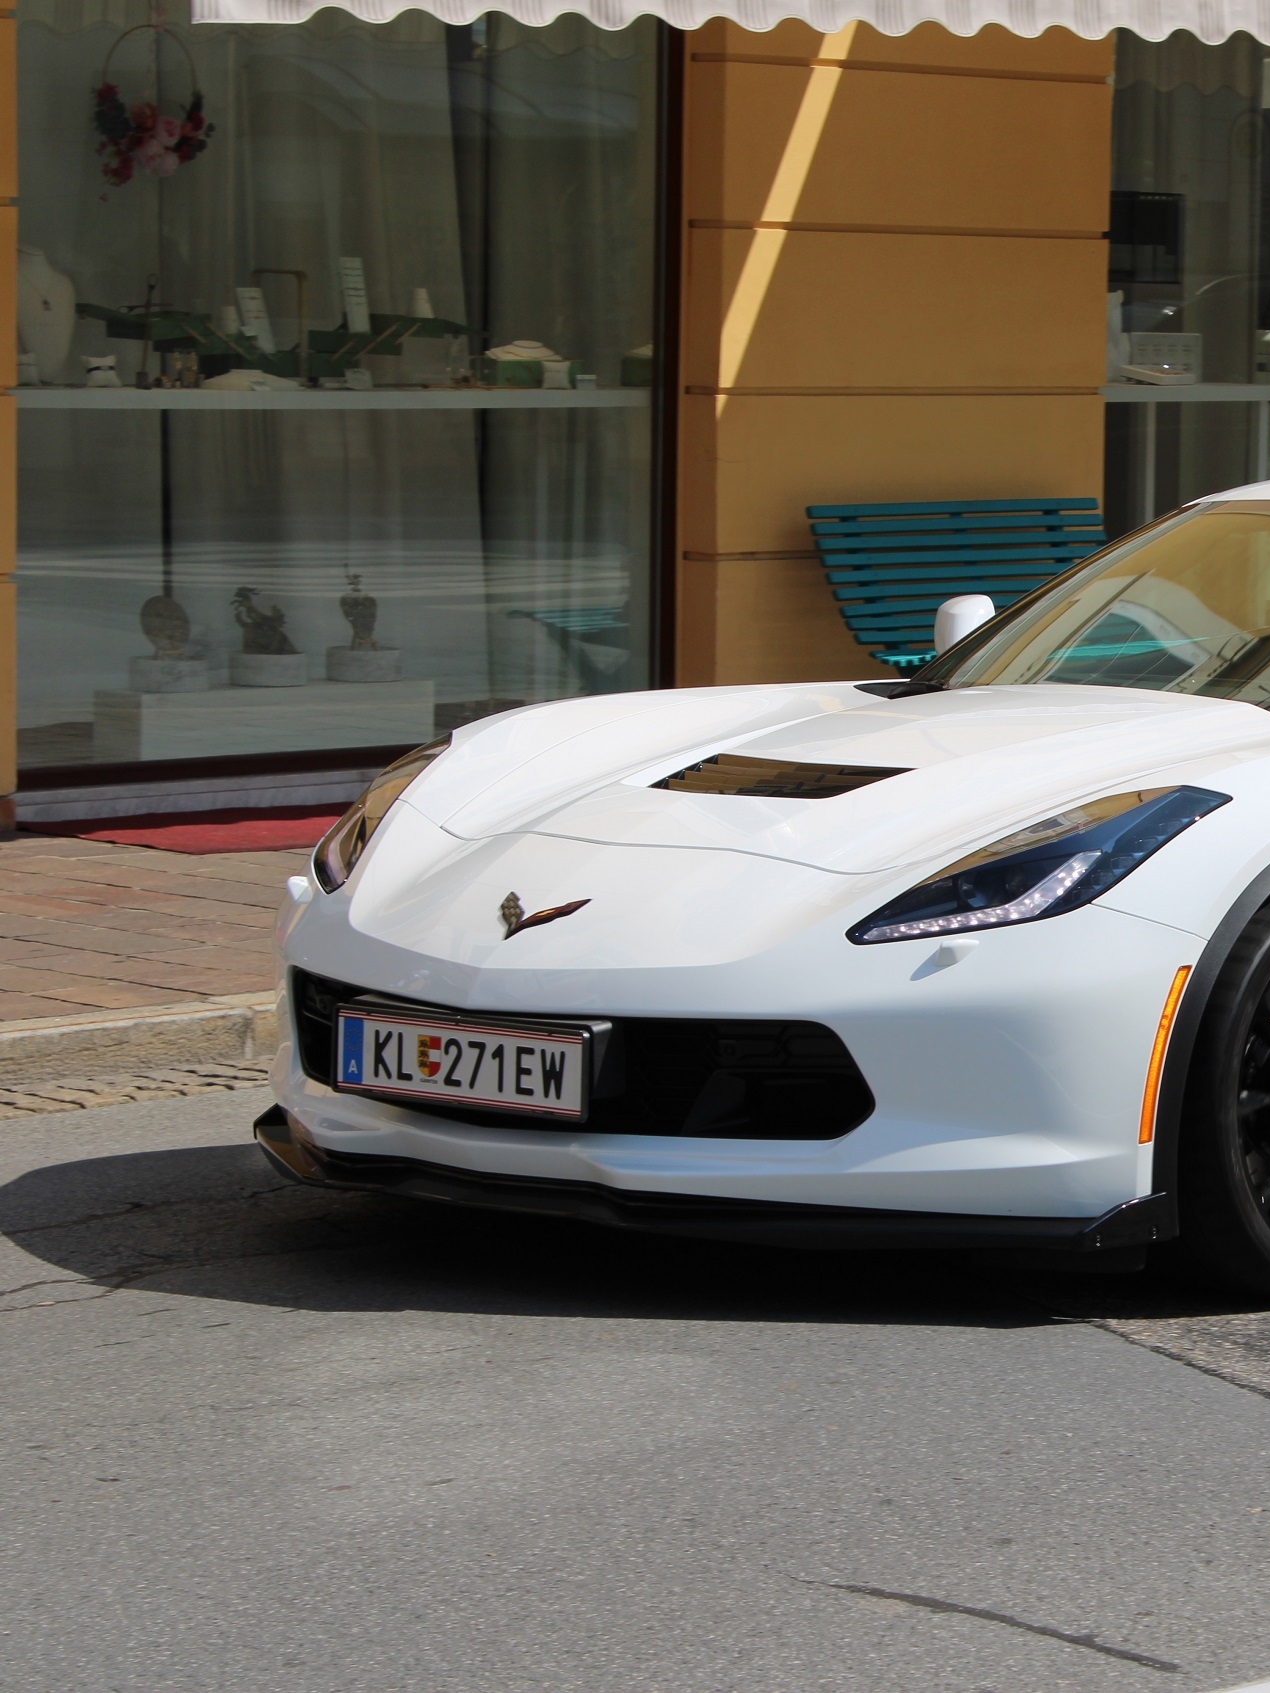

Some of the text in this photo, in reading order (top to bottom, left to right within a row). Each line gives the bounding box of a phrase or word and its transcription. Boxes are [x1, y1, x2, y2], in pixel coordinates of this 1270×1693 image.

[348, 1058, 358, 1075] A
[373, 1028, 566, 1101] KL 271EW
